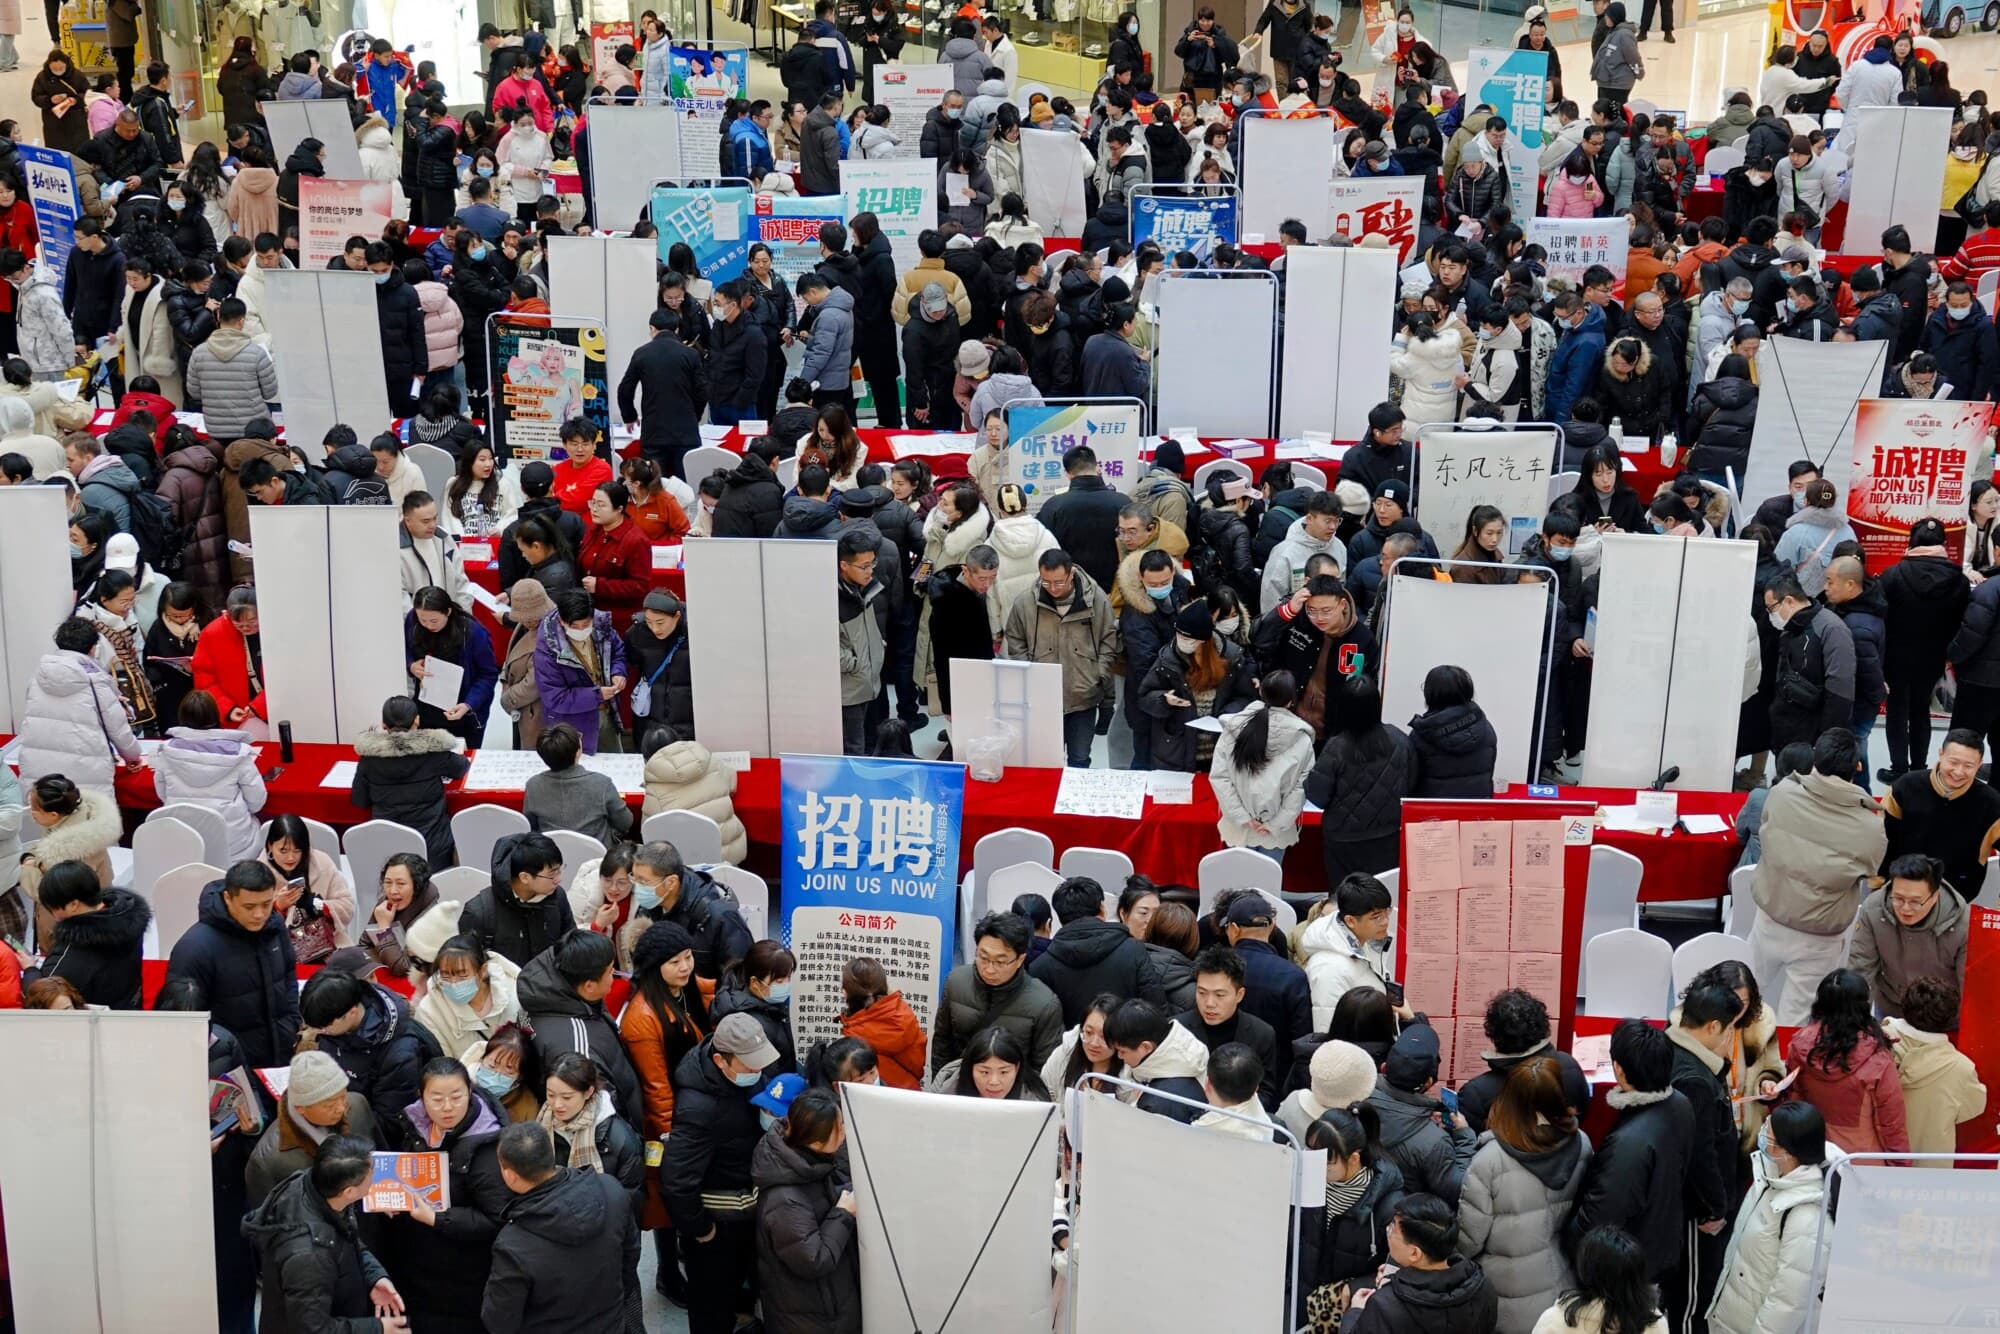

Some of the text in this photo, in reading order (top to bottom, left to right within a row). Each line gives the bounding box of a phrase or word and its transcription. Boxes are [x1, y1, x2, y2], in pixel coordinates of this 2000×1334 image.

[1511, 73, 1544, 136] 招聘
[309, 205, 363, 216] 你的岗位与梦想
[856, 186, 923, 216] 招聘
[759, 219, 840, 246] 诚聘英
[1150, 208, 1213, 241] 诚聘
[1550, 235, 1609, 249] 招聘精英
[1548, 250, 1609, 264] 成就非凡
[1101, 422, 1127, 434] 钉钉
[1022, 460, 1062, 478] 这里
[1432, 453, 1545, 487] 东风汽车
[1871, 445, 1967, 501] 诚聘
[1871, 478, 1925, 493] JOIN US
[1869, 492, 1923, 505] 加入我们
[797, 790, 935, 877] 招聘
[935, 803, 949, 881] 欢迎您的加入
[801, 873, 937, 899] JOIN US NOW
[838, 913, 897, 930] 公司简介
[816, 932, 931, 949] 山东正达人力资源有限公司成立
